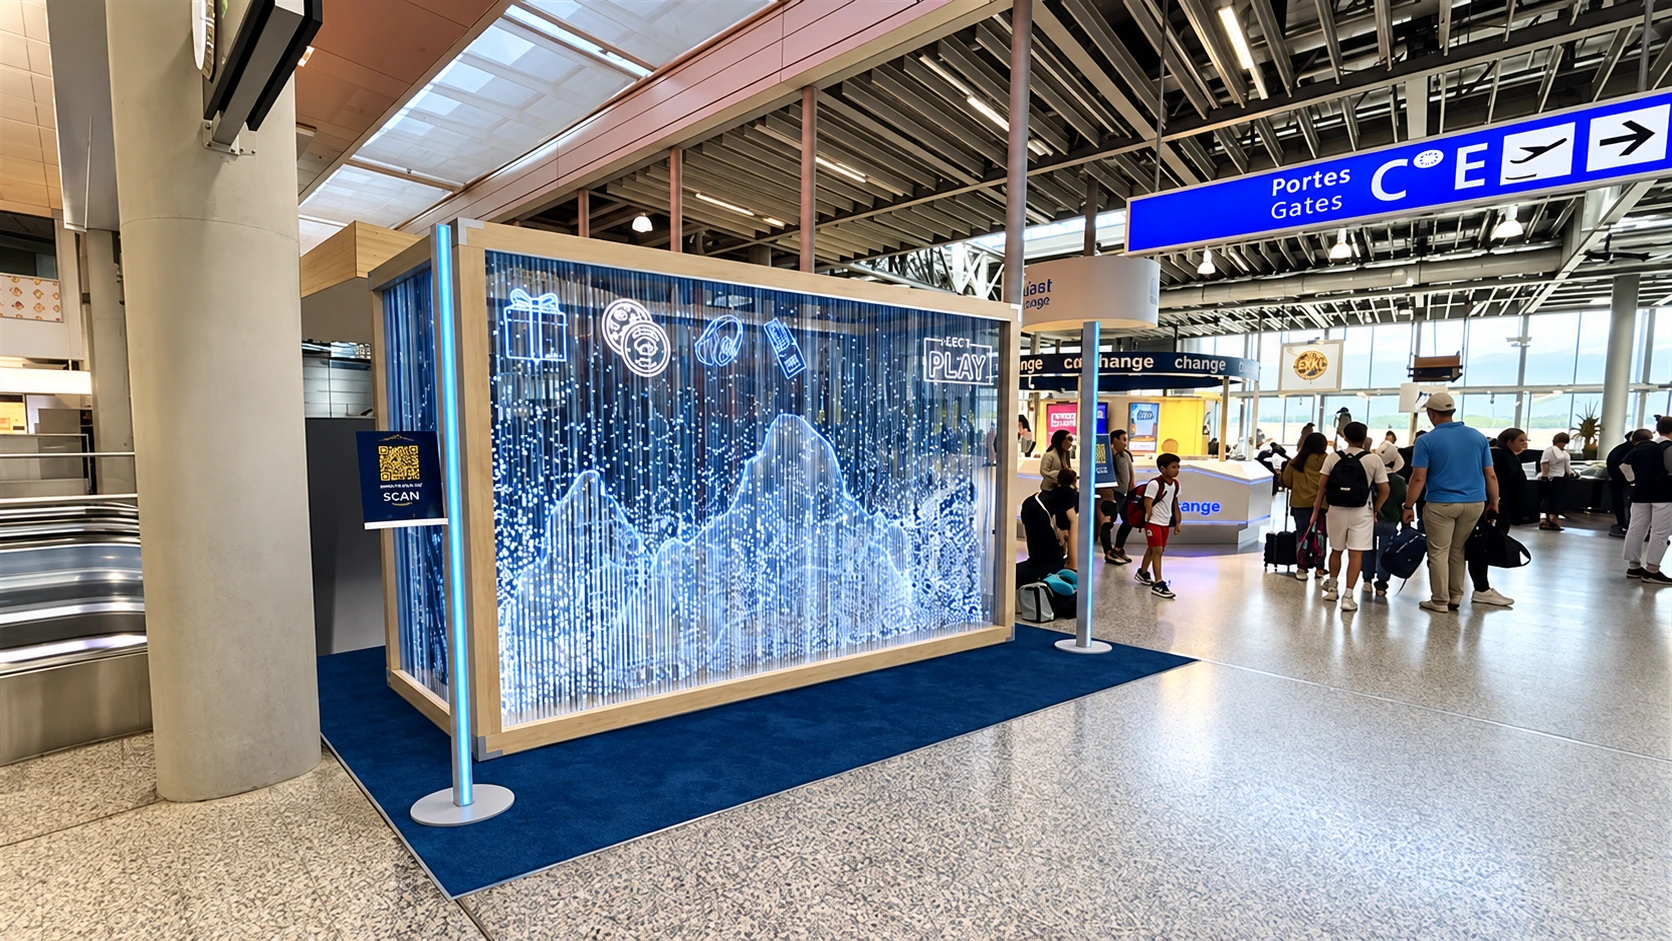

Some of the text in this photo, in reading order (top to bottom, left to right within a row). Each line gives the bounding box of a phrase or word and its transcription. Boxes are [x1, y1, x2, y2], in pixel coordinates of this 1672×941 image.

[1272, 168, 1350, 197] Portes
[1371, 142, 1488, 201] C E
[1271, 194, 1343, 220] Gates
[928, 350, 987, 381] PLAY
[1174, 355, 1227, 374] change
[382, 491, 420, 502] SCAN
